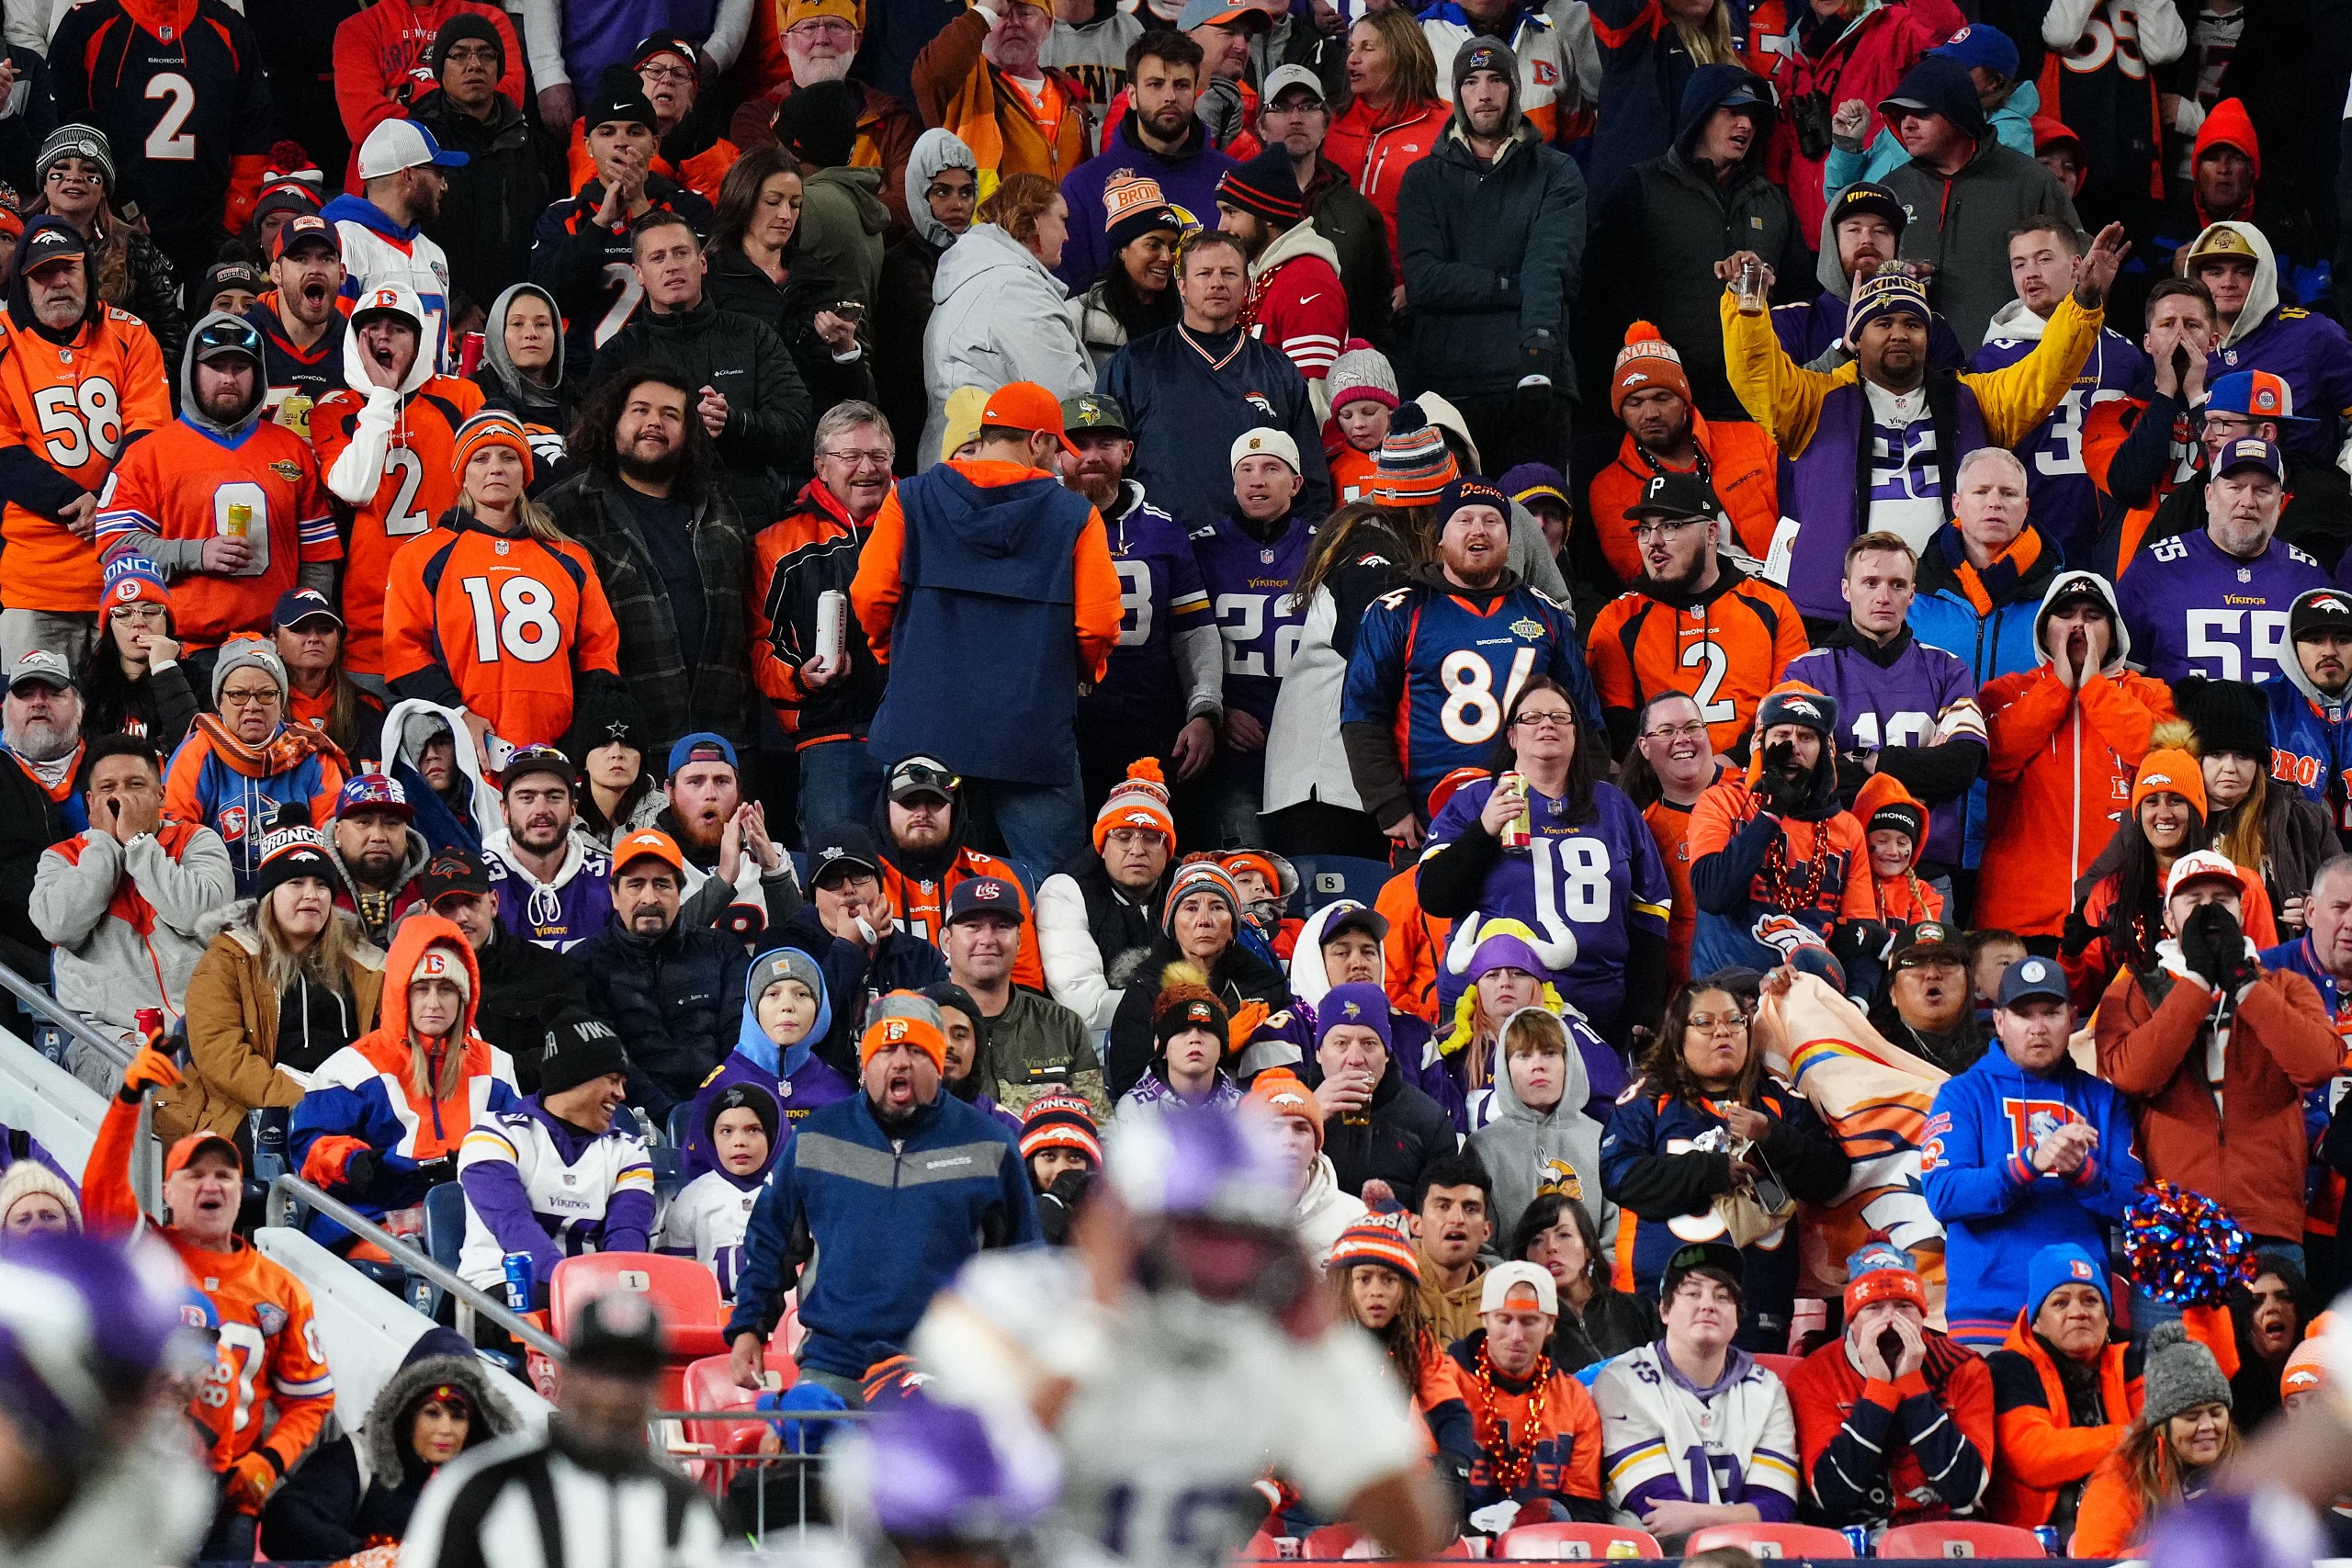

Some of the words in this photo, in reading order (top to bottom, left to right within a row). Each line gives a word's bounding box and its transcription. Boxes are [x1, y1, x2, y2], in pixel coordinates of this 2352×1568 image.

[144, 73, 197, 160] 2
[1857, 277, 1921, 300] VIKINGS
[34, 377, 123, 468] 58
[385, 449, 428, 536] 2
[1650, 477, 1666, 499] P
[1725, 468, 1763, 492] BRONCOS
[463, 575, 562, 663] 18
[1476, 637, 1512, 646] BRONCOS
[1682, 640, 1735, 723] 2
[1874, 811, 1915, 828] BRONCOS
[1527, 836, 1611, 922] 18
[926, 1156, 972, 1170] BRONCOS
